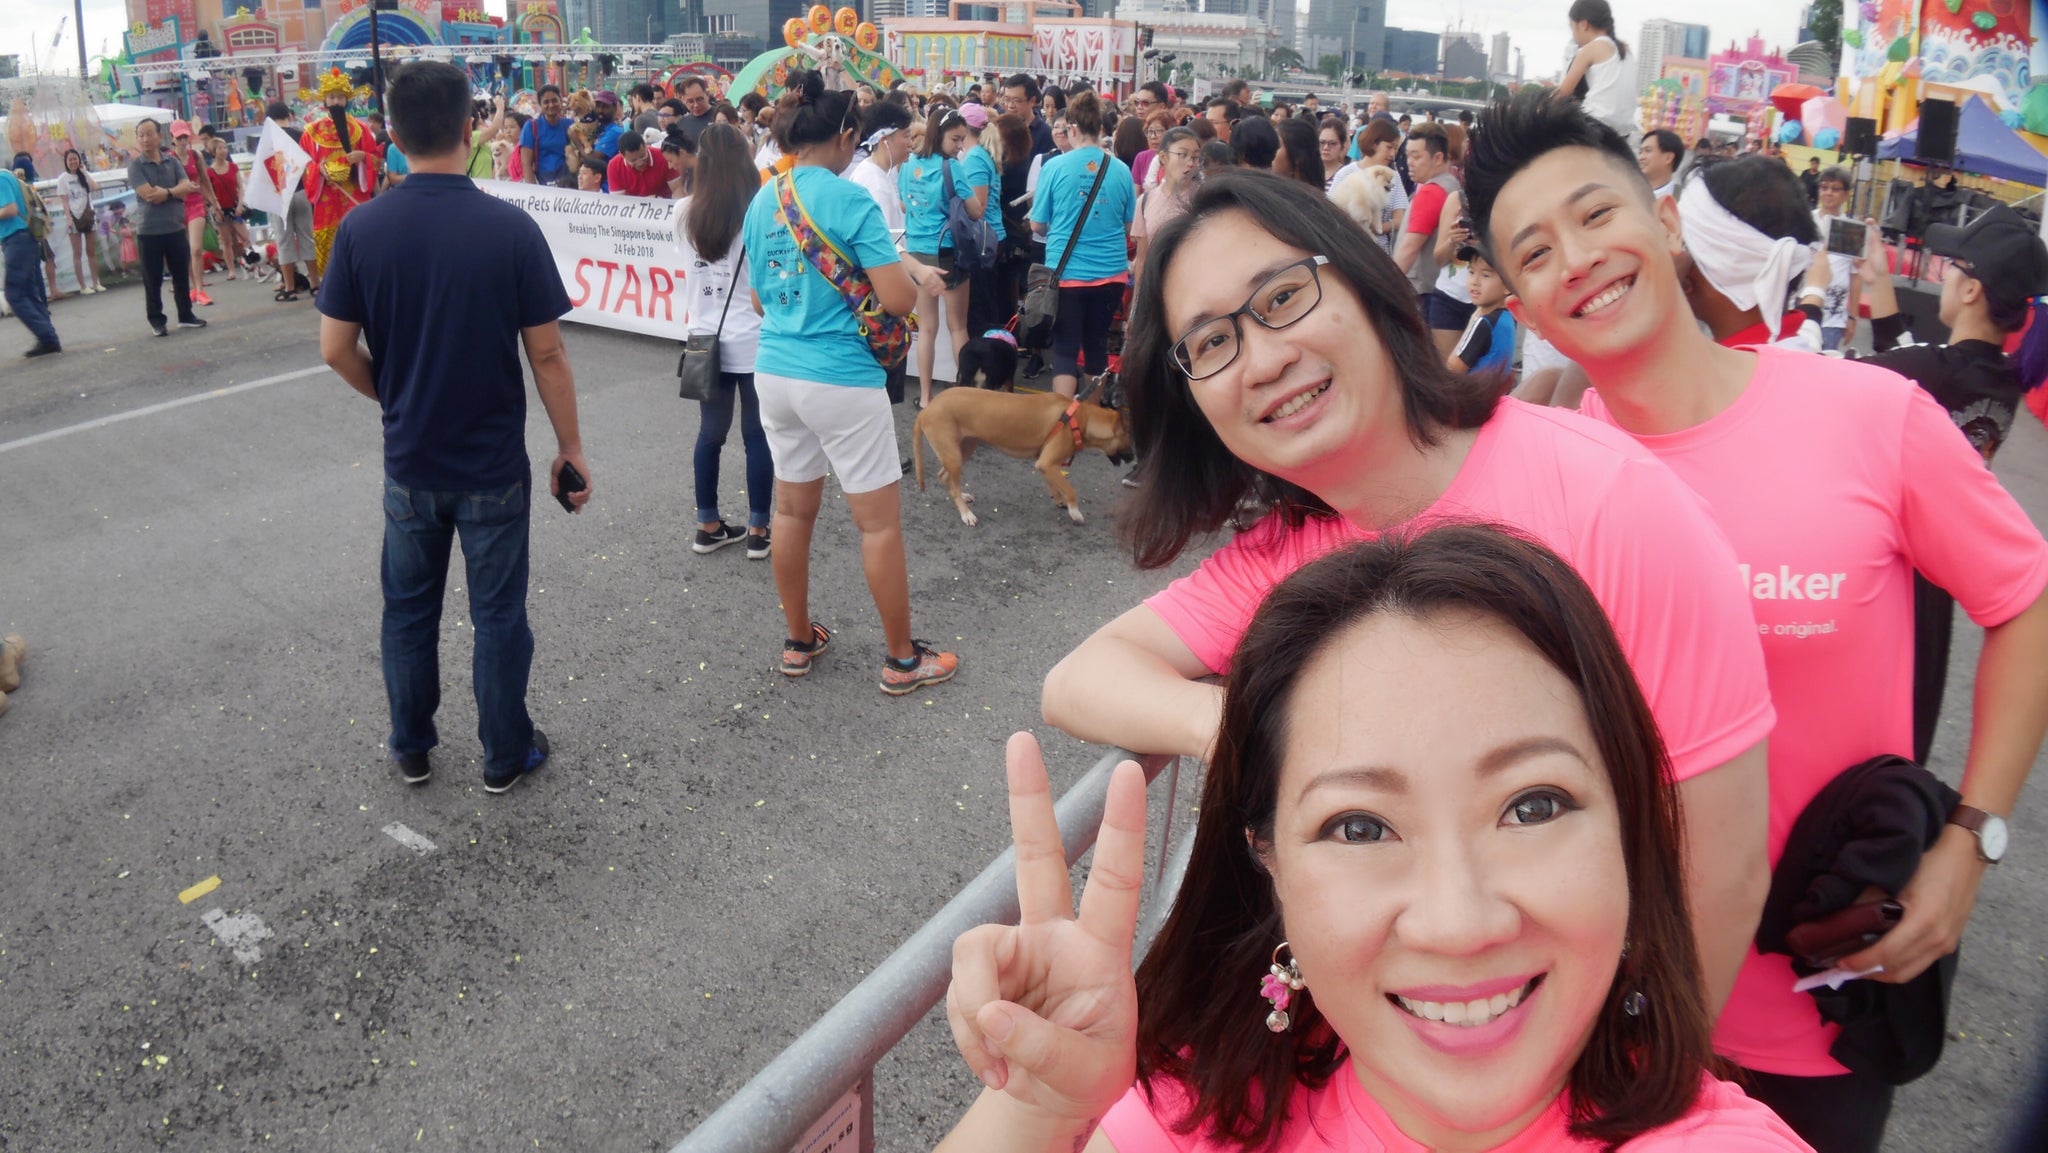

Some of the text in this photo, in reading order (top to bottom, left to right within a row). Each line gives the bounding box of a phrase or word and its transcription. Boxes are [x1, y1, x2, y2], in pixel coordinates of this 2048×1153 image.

[528, 195, 550, 212] Pets
[553, 196, 618, 217] Walkathon
[620, 202, 636, 218] at
[637, 202, 663, 220] The
[568, 222, 674, 242] Breaking The Singapore Book of
[614, 243, 655, 258] 24 Feb 2018
[1774, 619, 1839, 639] original.
